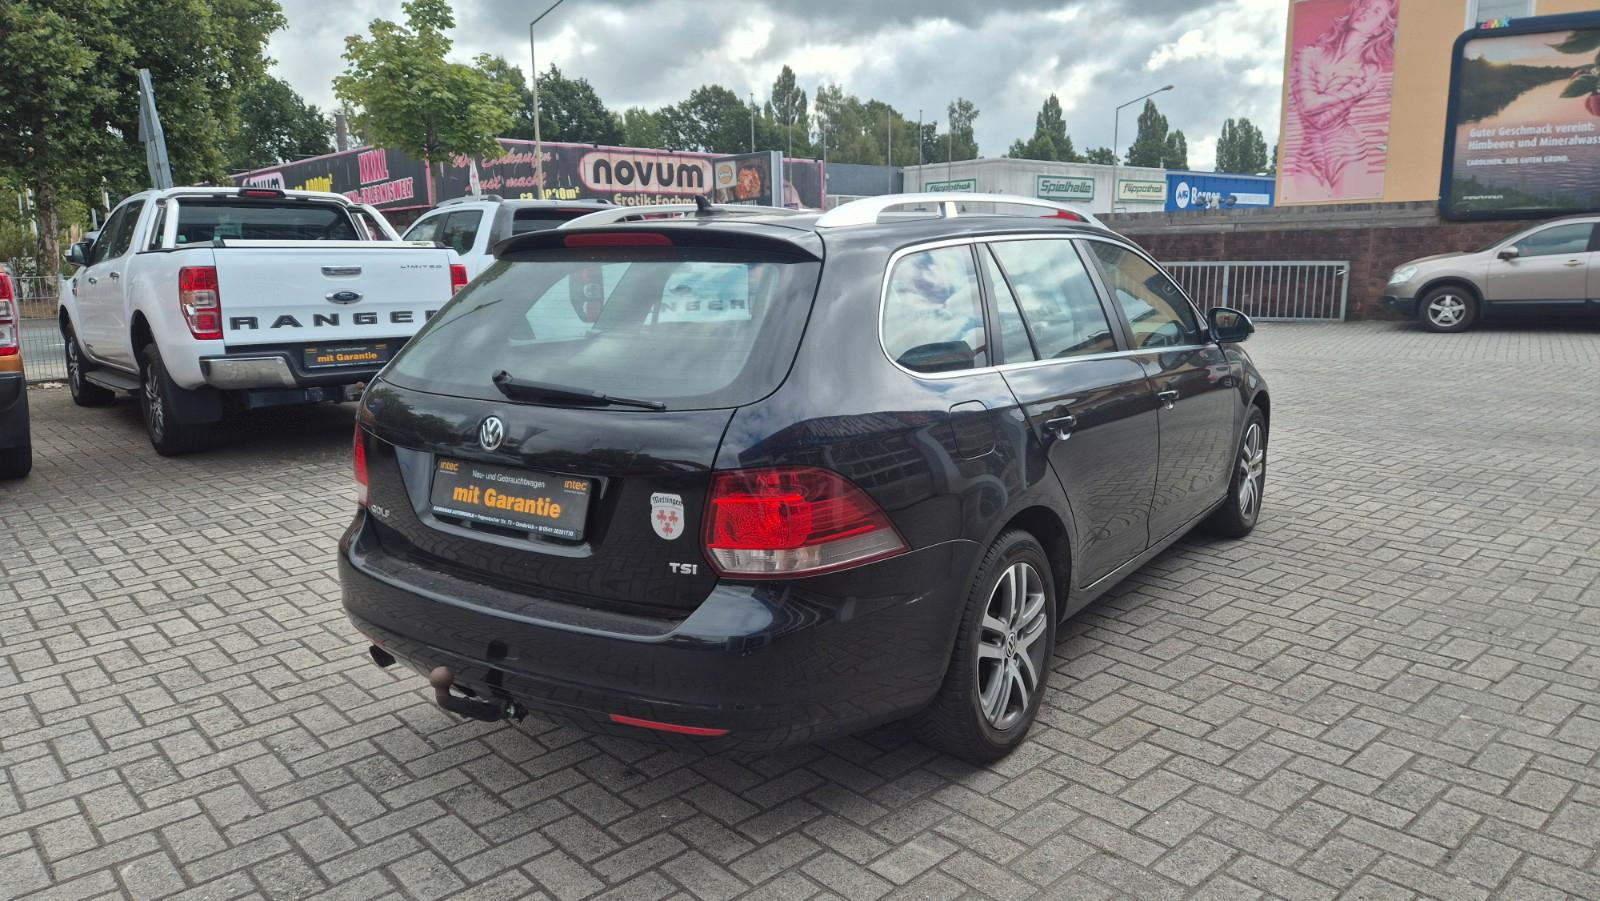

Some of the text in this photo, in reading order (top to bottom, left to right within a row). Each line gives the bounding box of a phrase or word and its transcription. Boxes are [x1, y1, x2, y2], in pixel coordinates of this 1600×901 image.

[1470, 121, 1595, 137] Guter Geschmack vereint:
[1468, 139, 1516, 150] Himbeere
[1518, 137, 1537, 148] und
[593, 158, 704, 188] novum
[1040, 180, 1092, 194] Spielhalle
[317, 354, 334, 363] mit
[485, 471, 496, 482] und
[563, 479, 588, 492] intec
[453, 485, 561, 519] mit Garantie
[371, 504, 390, 518] GOLF
[668, 562, 699, 576] TSI
